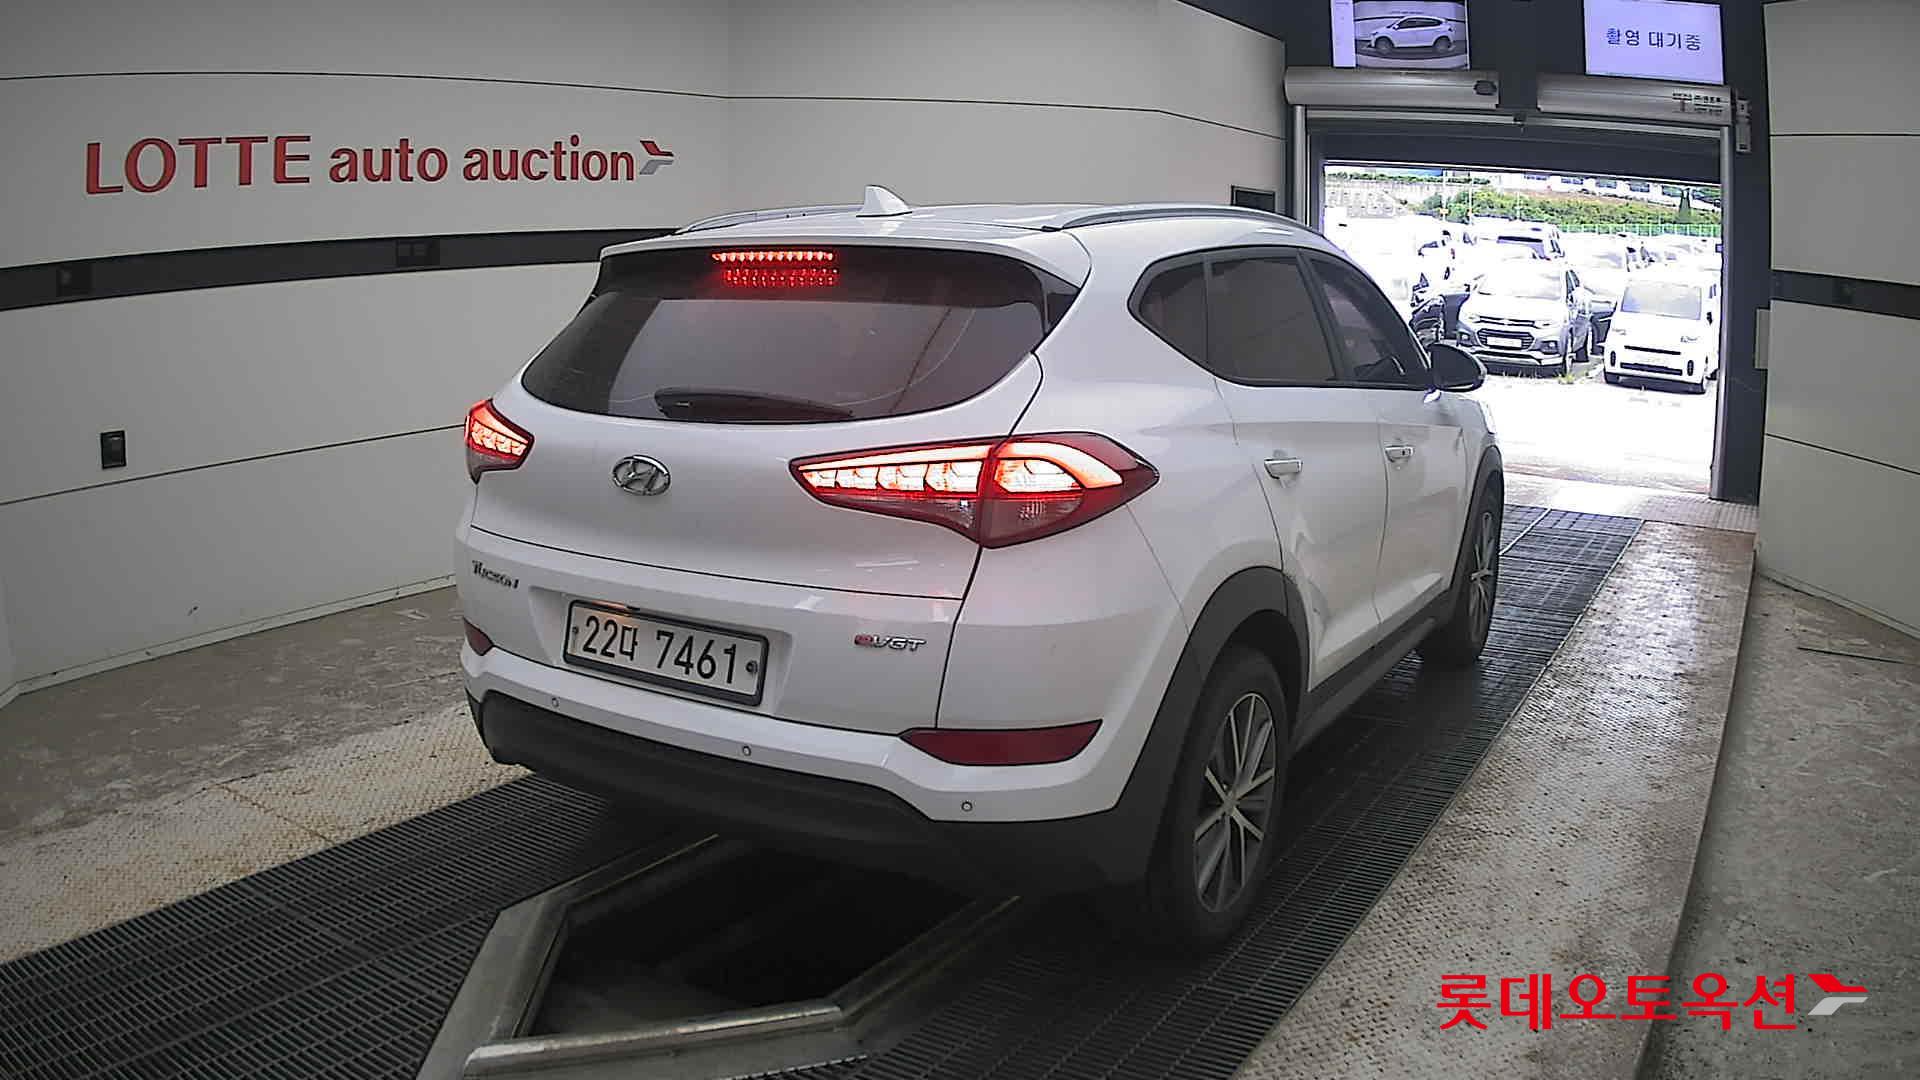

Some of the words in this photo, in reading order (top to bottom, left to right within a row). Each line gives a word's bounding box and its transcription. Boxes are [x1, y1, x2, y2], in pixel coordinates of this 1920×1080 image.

[1649, 32, 1701, 51] 대기중
[86, 135, 311, 195] LOTTE
[329, 138, 448, 182] auto
[463, 135, 635, 182] auction
[582, 615, 638, 661] 22다
[656, 630, 738, 684] 7461
